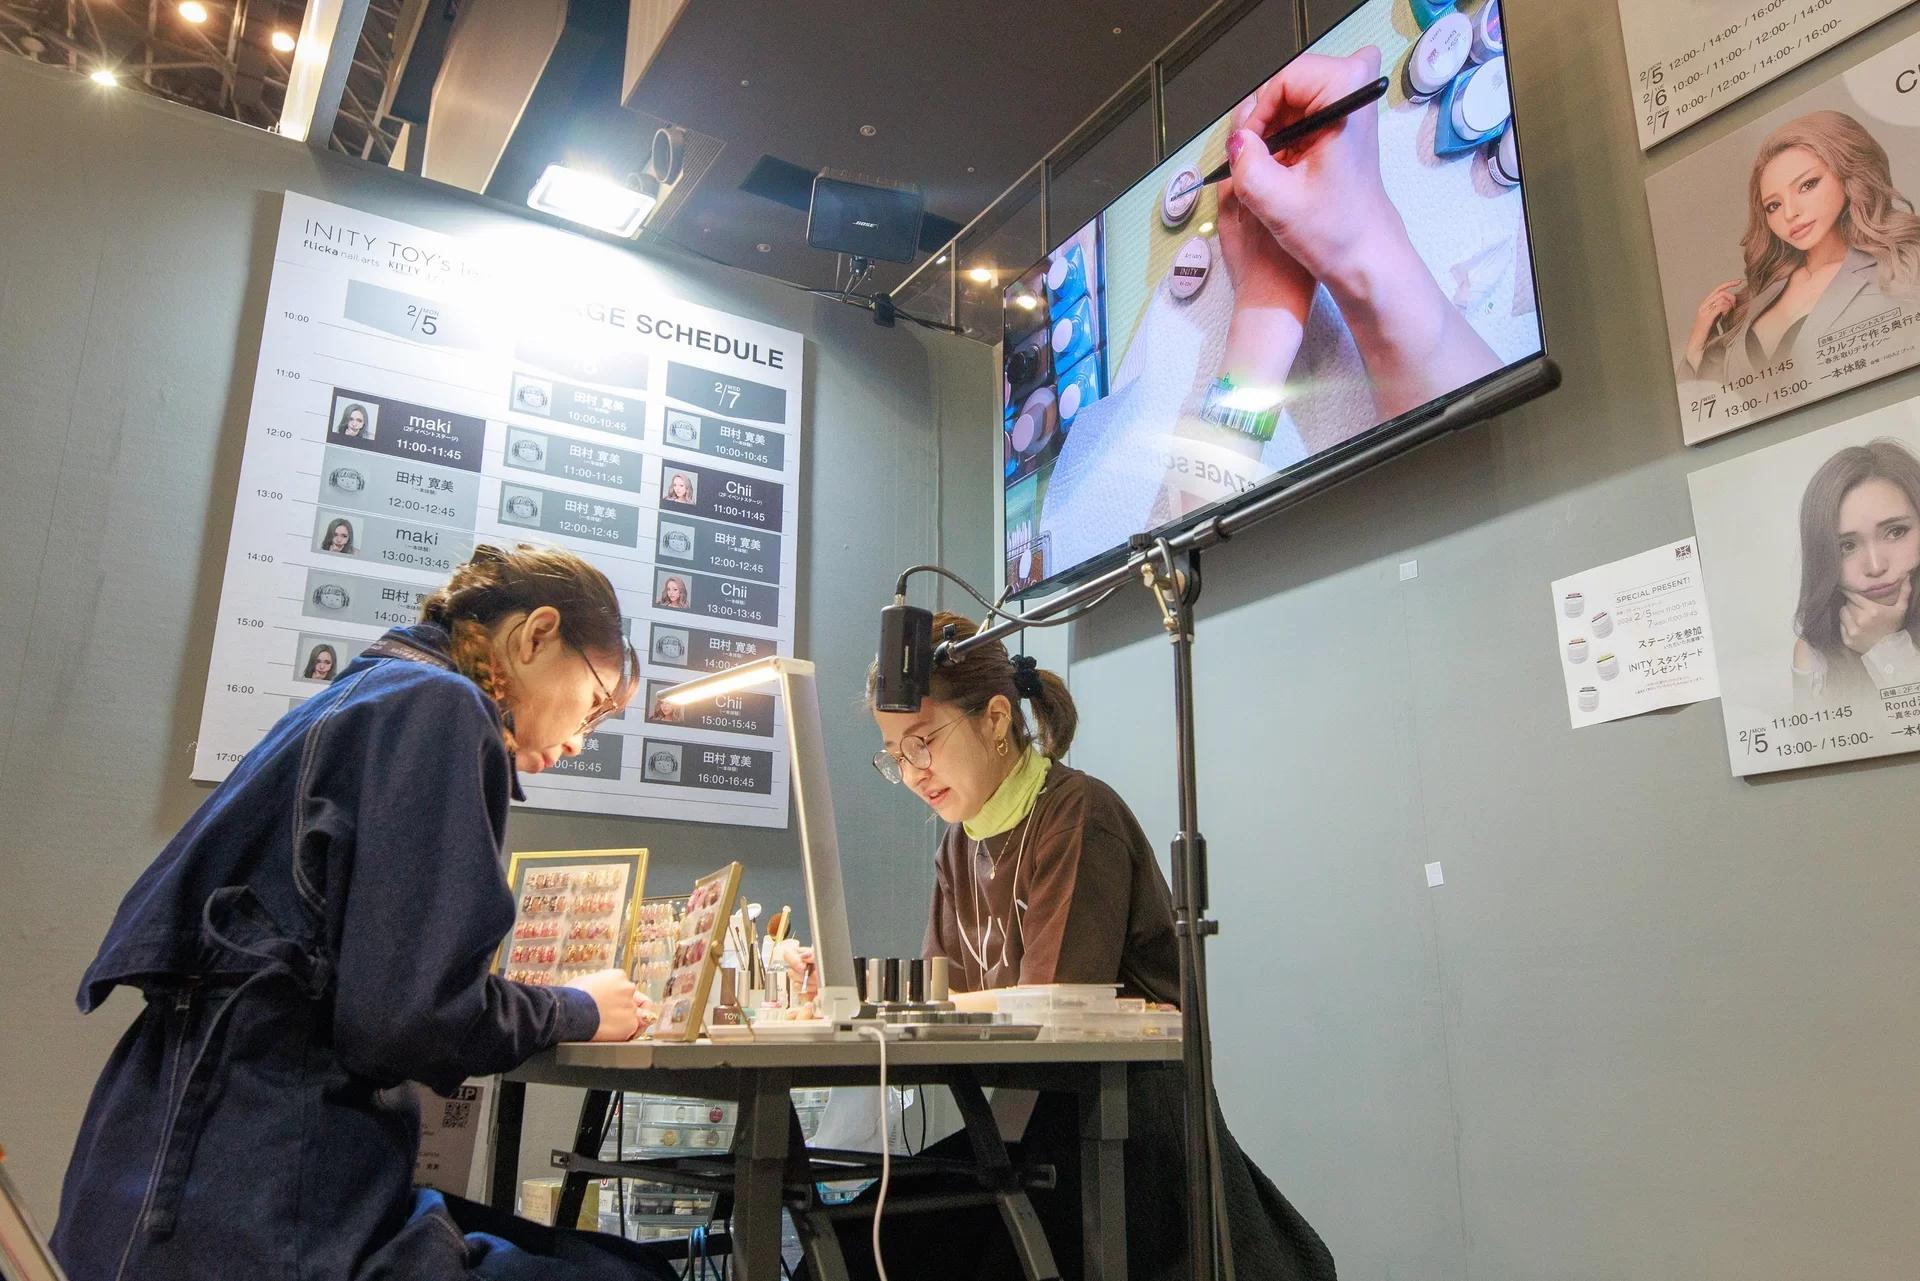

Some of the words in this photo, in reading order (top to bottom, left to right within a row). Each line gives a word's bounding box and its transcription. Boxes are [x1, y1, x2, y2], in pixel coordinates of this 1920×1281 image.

[1669, 49, 1700, 71] 12:00-
[1709, 24, 1742, 46] 14:00-
[1673, 72, 1704, 93] 10:00-
[1713, 48, 1746, 70] 11:00-
[1755, 22, 1790, 45] 12:00-
[1676, 95, 1707, 116] 10:00-
[1717, 71, 1750, 93] 12:00-
[1759, 46, 1795, 69] 14:00-
[1806, 19, 1842, 43] 16:00-
[1895, 64, 1920, 94] C
[304, 218, 377, 251] INITY
[303, 239, 339, 256] flicka
[284, 311, 310, 324] 10:00
[636, 313, 784, 370] SCHEDULE
[275, 368, 301, 381] 11:00
[1721, 358, 1794, 394] 11:00-11:45
[1725, 398, 1761, 417] 13:00-
[1774, 379, 1813, 400] 15:00-
[266, 427, 292, 440] 12:00
[409, 415, 452, 434] maki
[397, 439, 462, 460] 11:00-11:45
[715, 444, 768, 464] 10:00-10:45
[396, 471, 423, 487] 田村
[563, 465, 624, 485] 11:00-11:45
[256, 489, 283, 501] 13:00
[726, 480, 752, 497] Chii
[388, 497, 455, 518] 12:00-12:45
[713, 504, 766, 522] 11:00-11:45
[396, 528, 439, 546] maki
[559, 521, 620, 540] 12:00-12:45
[247, 552, 274, 564] 14:00
[382, 550, 450, 569] 13:00-13:45
[710, 556, 764, 574] 12:00-12:45
[381, 587, 409, 603] 田村
[721, 582, 748, 599] Chii
[1616, 589, 1650, 603] SPECIAL
[374, 610, 417, 624] 14:00-1
[707, 603, 762, 621] 13:00-13:45
[237, 617, 265, 629] 15:00
[704, 658, 738, 671] 14:00-
[1628, 659, 1653, 672] INITY
[226, 683, 255, 695] 16:00
[715, 695, 743, 710] Chii
[701, 715, 757, 731] 15:00-15:45
[1772, 705, 1853, 729] 11:00-11:45
[1776, 741, 1818, 757] 13:00-
[1830, 731, 1873, 749] 15:00-
[698, 773, 755, 788] 16:00-16:45
